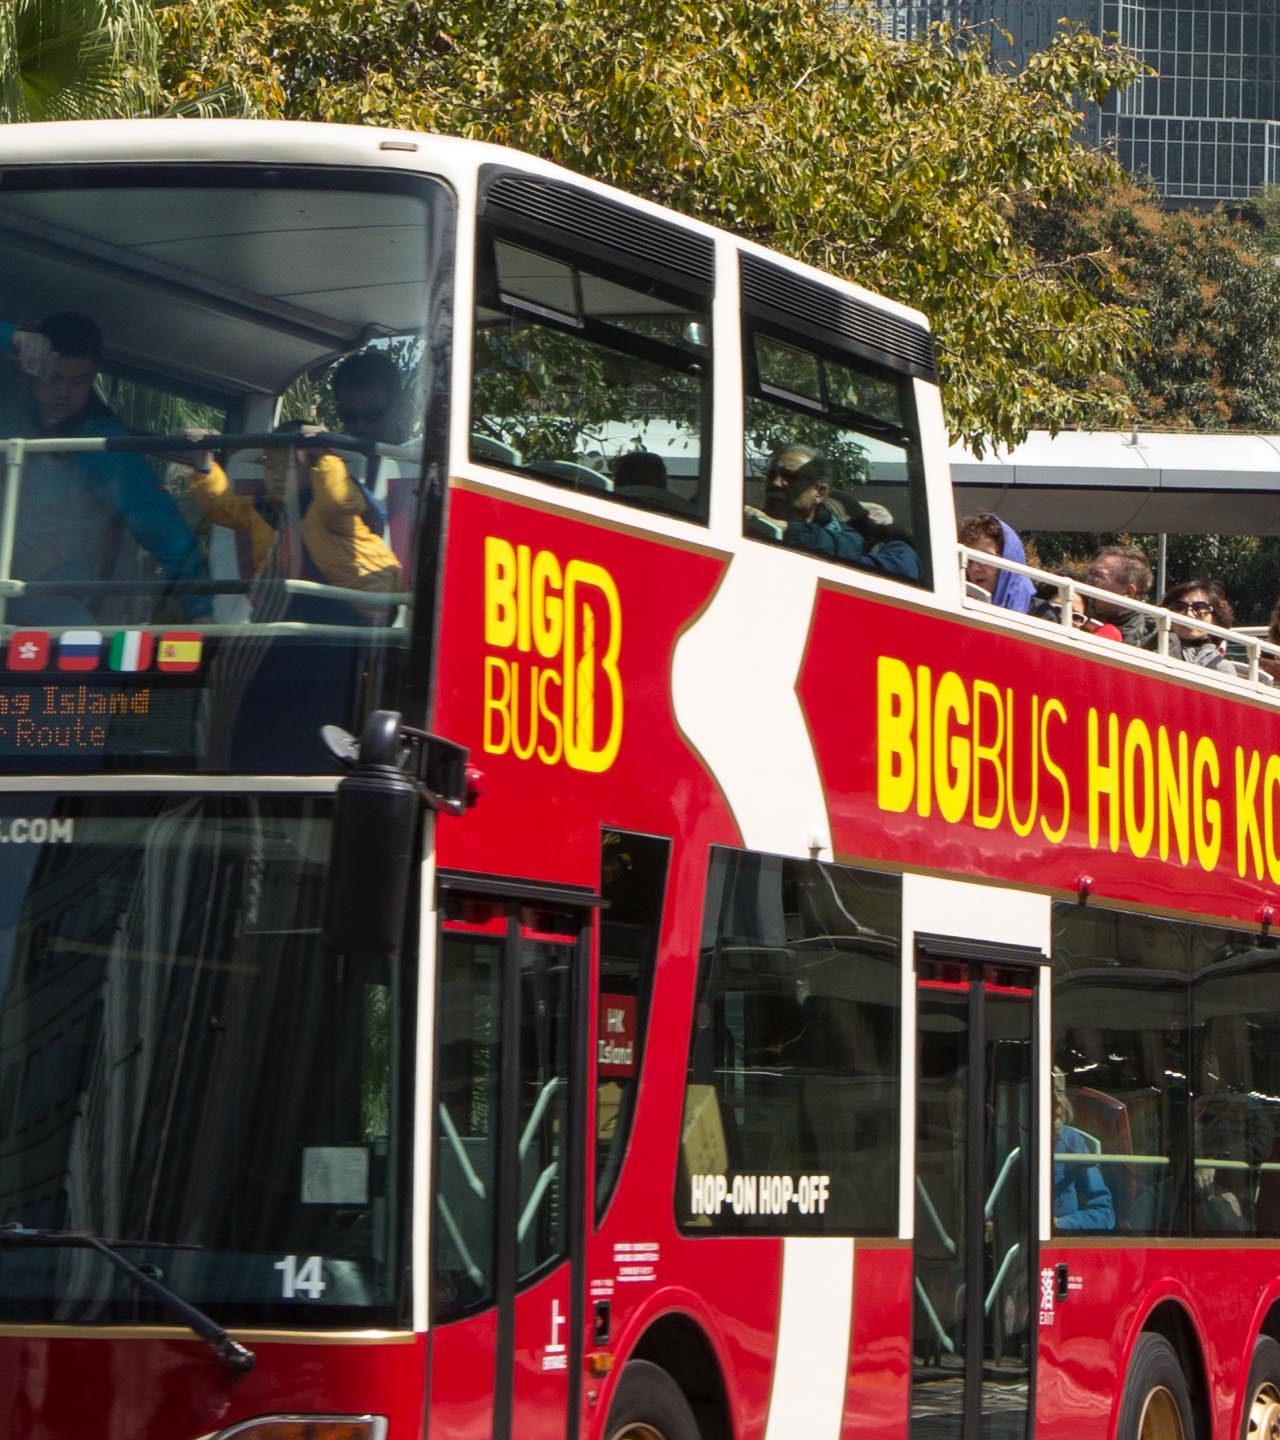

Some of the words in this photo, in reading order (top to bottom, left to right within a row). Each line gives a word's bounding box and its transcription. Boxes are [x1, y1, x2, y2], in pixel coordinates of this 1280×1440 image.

[485, 536, 563, 658] BIG
[42, 686, 150, 714] Island
[483, 656, 563, 765] BUS
[16, 718, 106, 747] Route
[1088, 707, 1221, 872] HONG
[607, 1008, 625, 1033] HK
[598, 1040, 633, 1065] Island
[691, 1174, 757, 1215] HOP-ON
[759, 1175, 830, 1215] HOP-OFF
[273, 1255, 326, 1299] 14
[545, 1299, 566, 1353] 上
